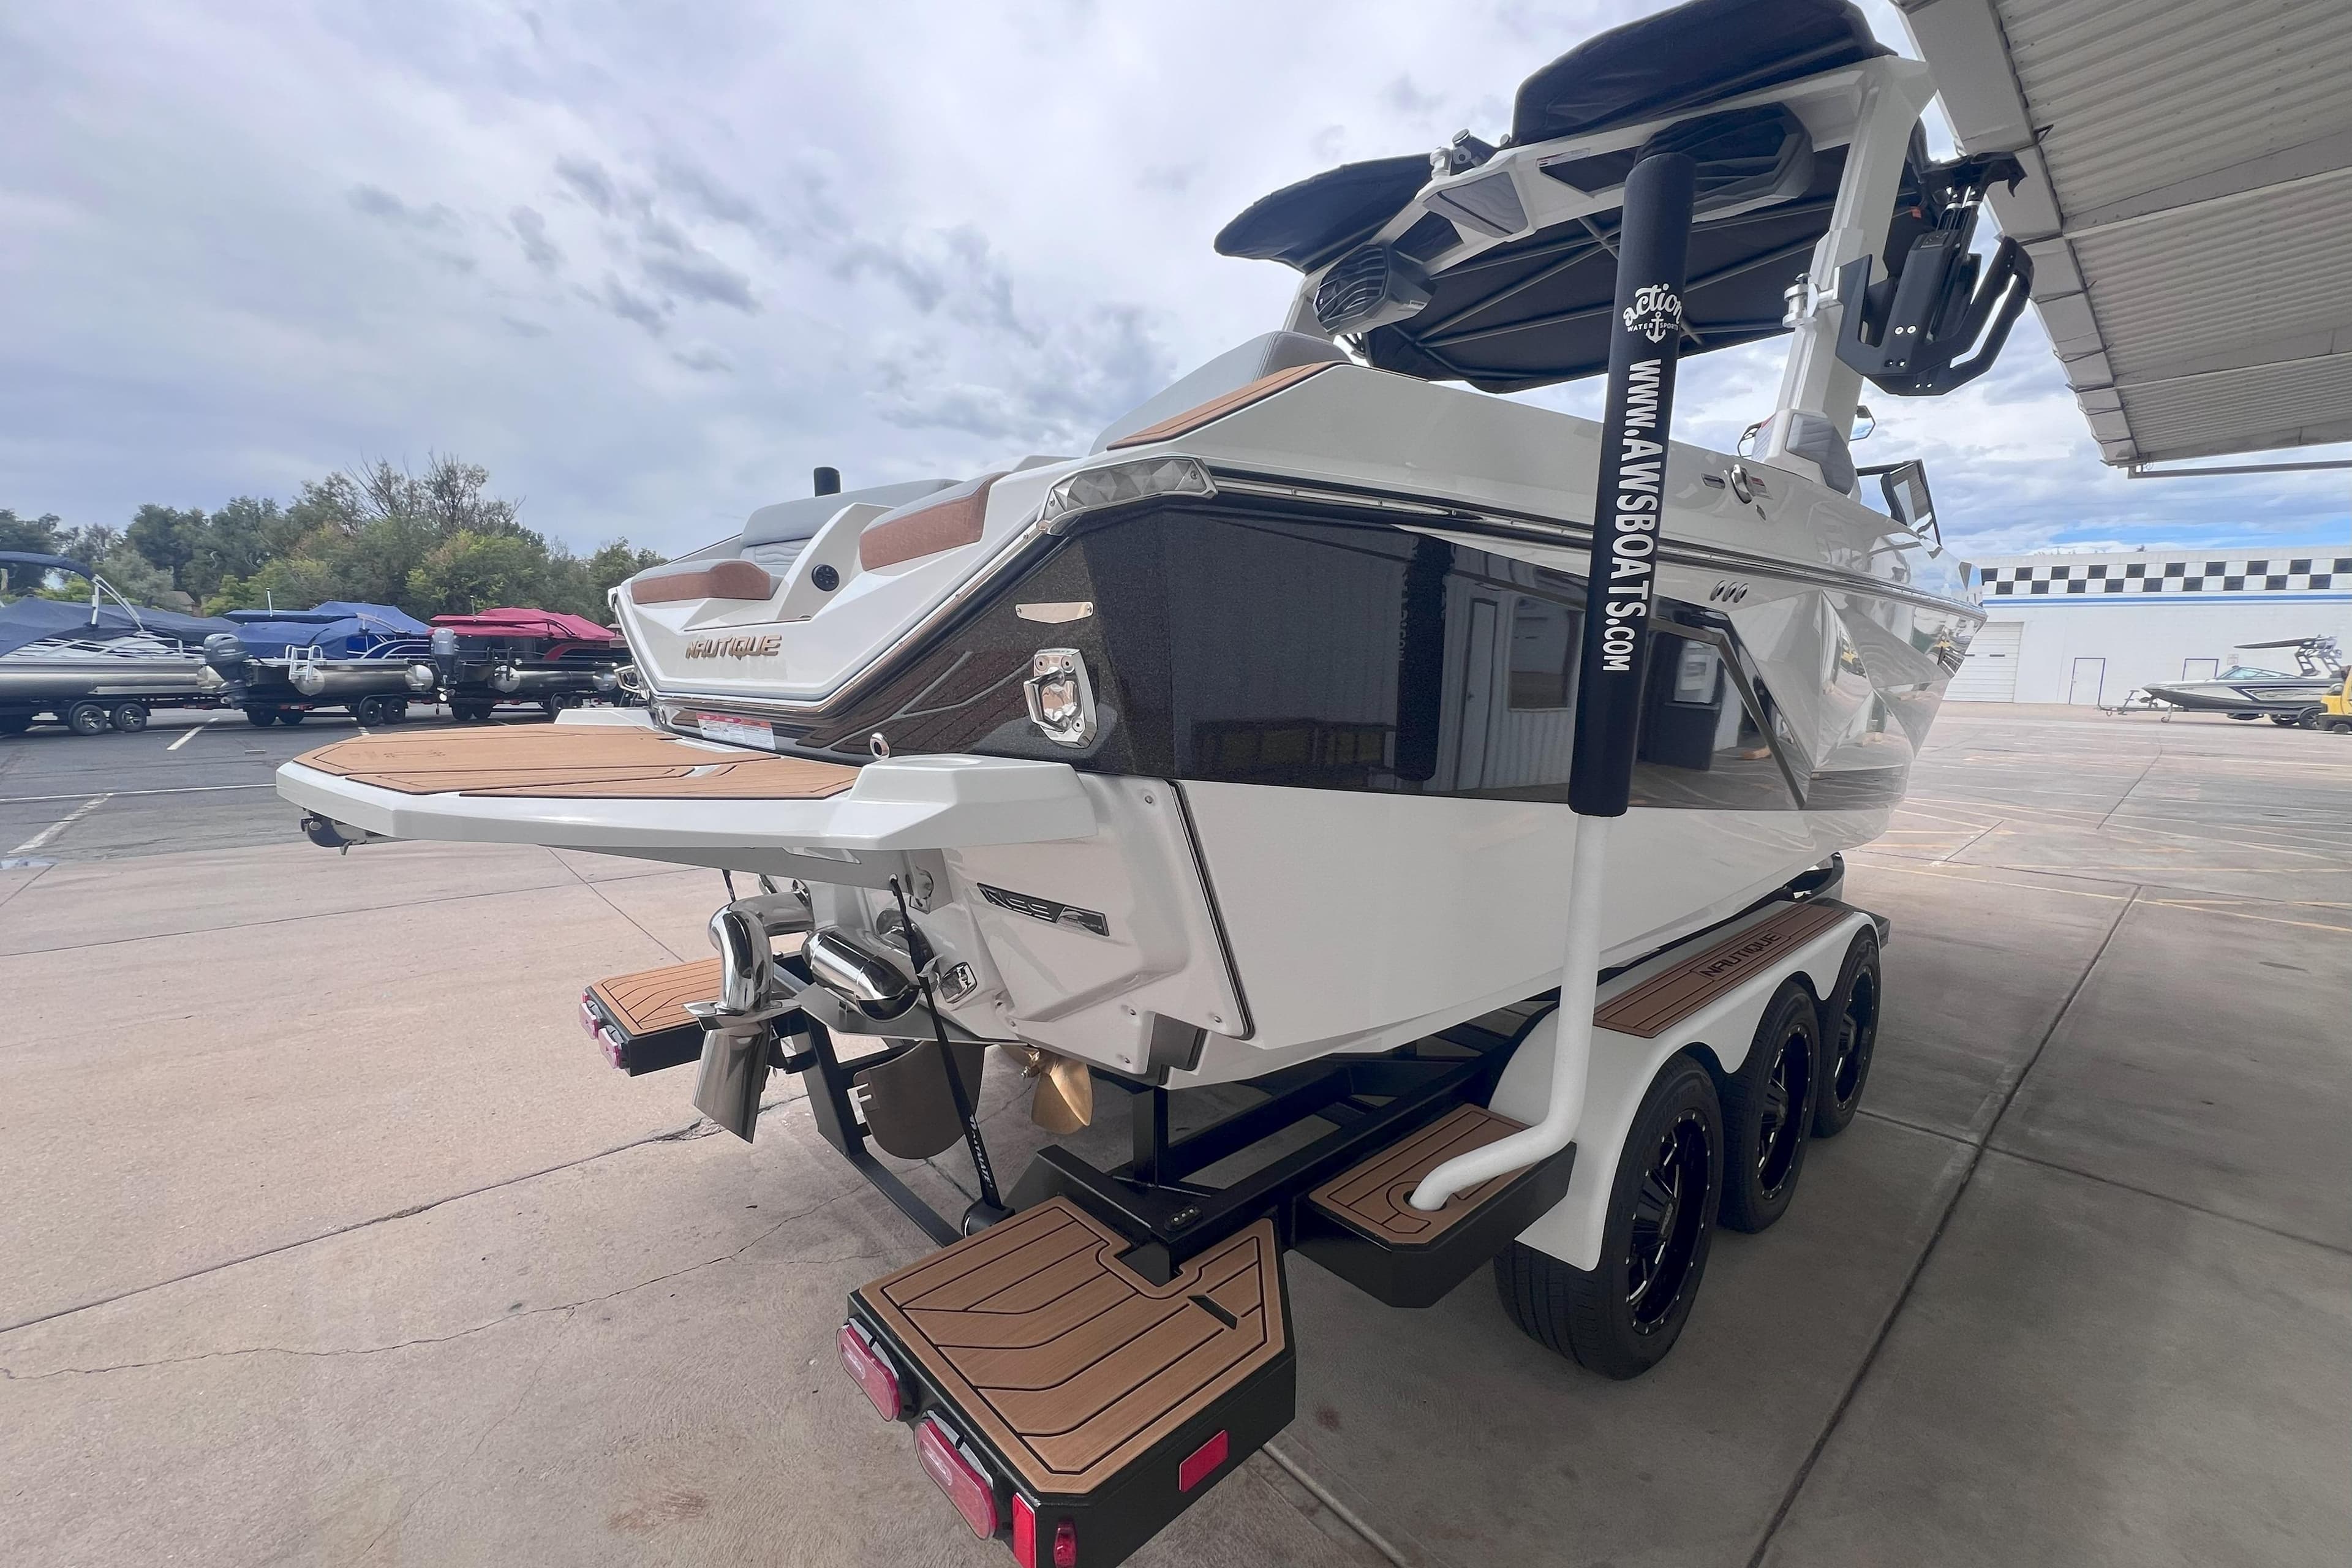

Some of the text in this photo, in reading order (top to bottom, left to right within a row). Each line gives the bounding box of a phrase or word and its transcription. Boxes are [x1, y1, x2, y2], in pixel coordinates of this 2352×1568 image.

[1627, 323, 1654, 332] WATER
[1602, 359, 1663, 671] WWW.AWSBOATS.COM
[685, 635, 782, 660] NAUTIQUE
[1700, 930, 1781, 978] NAUTIQUE
[969, 1114, 992, 1183] BTMATE
